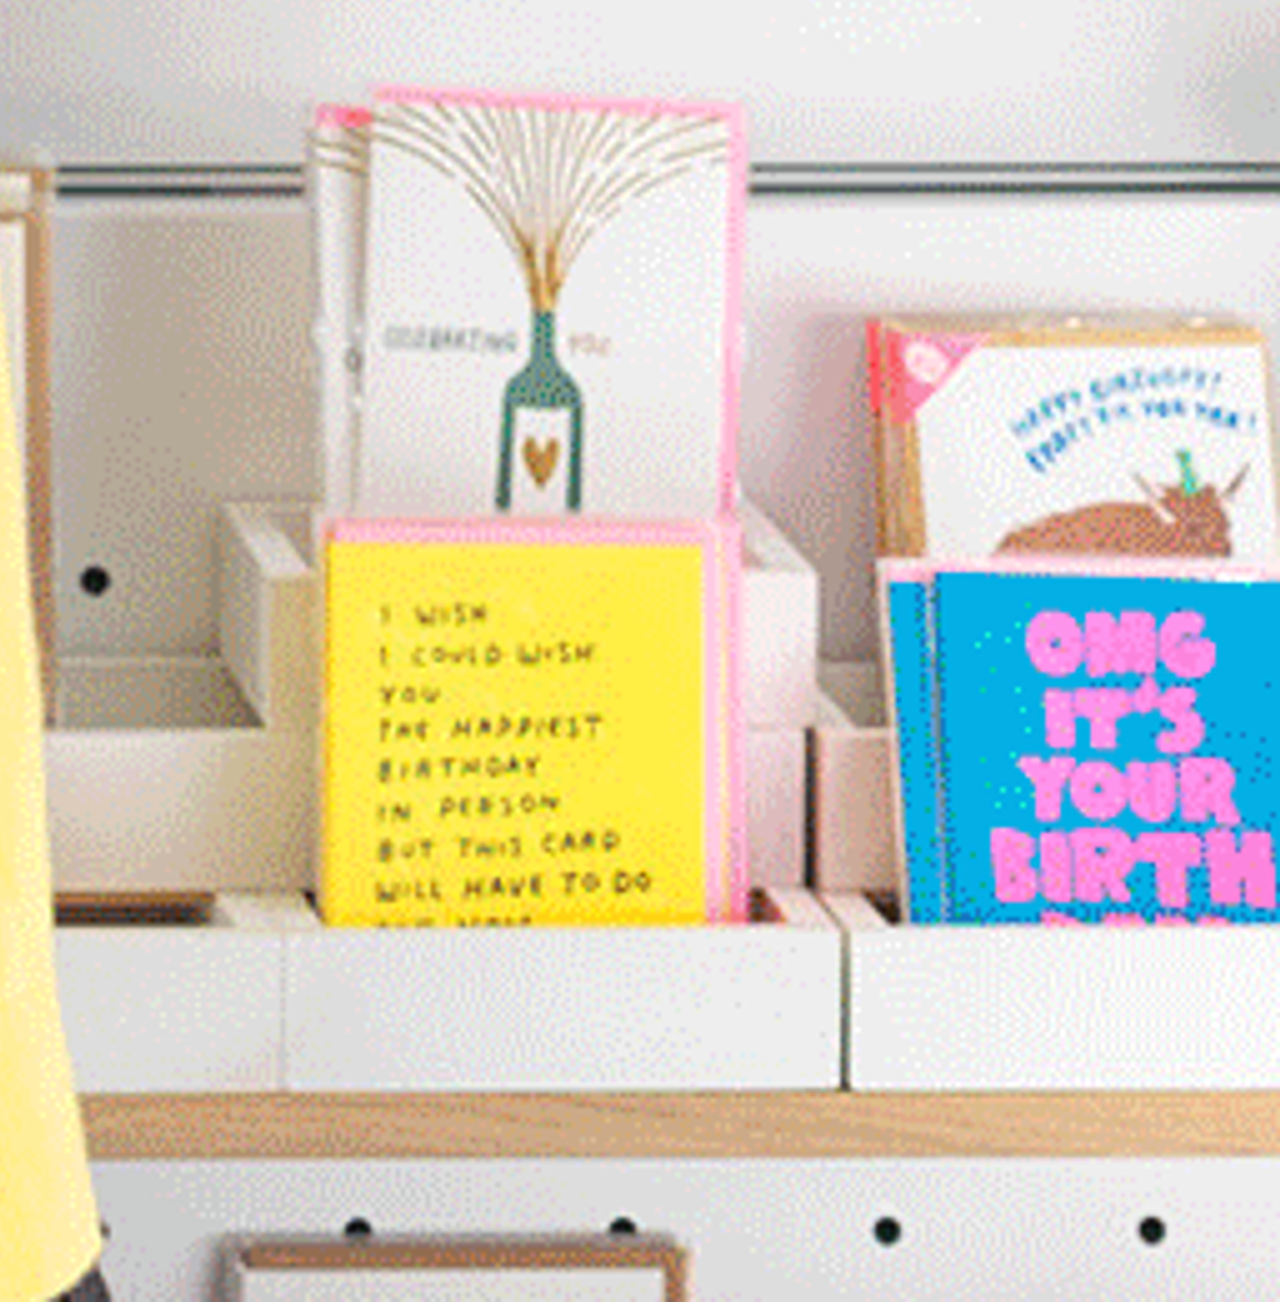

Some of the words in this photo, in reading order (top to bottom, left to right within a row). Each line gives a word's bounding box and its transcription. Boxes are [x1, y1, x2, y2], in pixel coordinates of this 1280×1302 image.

[414, 603, 487, 627] WISH
[412, 644, 502, 667] COULD
[516, 642, 596, 667] WISH
[1025, 609, 1217, 679] OMG
[379, 685, 441, 706] YOU
[379, 717, 429, 742] THE
[451, 713, 602, 740] HAPPIEST
[1042, 677, 1206, 754] IT'S
[378, 754, 541, 784] BIRTHDAY
[1016, 756, 1242, 825] YOUR
[377, 803, 411, 822] IN
[439, 793, 561, 818] PERSON
[377, 837, 434, 863] BUT
[457, 835, 522, 859] THIS
[541, 829, 621, 856] CARD
[989, 827, 1278, 910] BIRTH
[374, 879, 442, 903] WILL
[464, 873, 542, 898] HAVE
[562, 870, 601, 895] TO
[611, 869, 653, 894] DO
